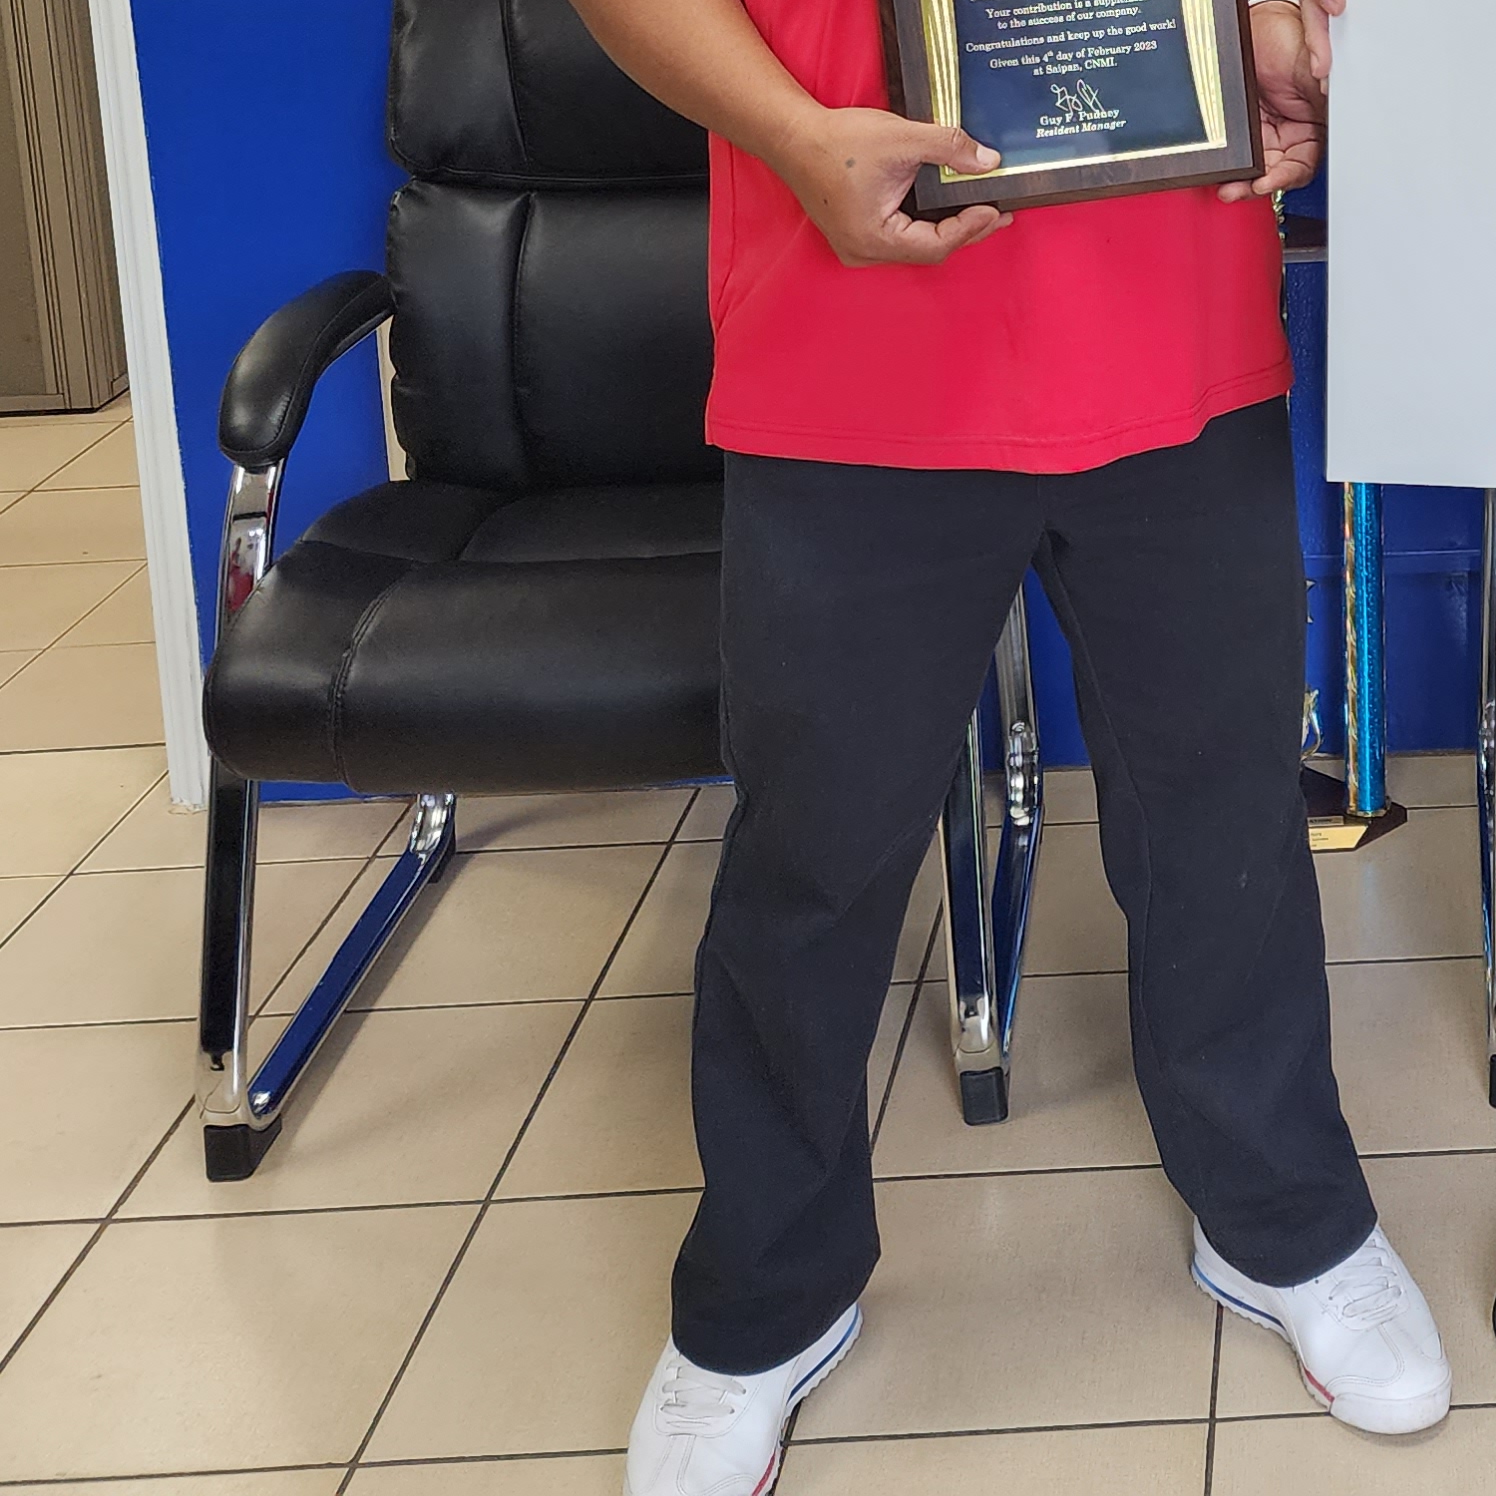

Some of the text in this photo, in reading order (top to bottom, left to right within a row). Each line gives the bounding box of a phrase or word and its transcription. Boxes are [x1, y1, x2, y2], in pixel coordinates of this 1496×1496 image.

[984, 7, 1011, 19] Your
[1013, 0, 1072, 15] contribution
[997, 21, 1008, 30] to
[1009, 17, 1027, 29] the
[1027, 14, 1064, 26] success
[1065, 11, 1077, 22] of
[1076, 11, 1095, 21] our
[965, 35, 1045, 52] Congratulations
[1046, 31, 1066, 43] and
[1067, 29, 1091, 41] keep
[1092, 29, 1106, 40] up
[1107, 25, 1123, 36] the
[1125, 22, 1147, 35] good
[989, 57, 1019, 69] Given
[1021, 54, 1041, 65] this
[1055, 51, 1074, 62] day
[1075, 48, 1086, 59] of
[1087, 44, 1132, 58] February
[1133, 40, 1158, 52] 2023
[1032, 66, 1044, 76] at
[1084, 56, 1118, 70] CNMI.
[1036, 120, 1127, 139] Resident Manager
[1039, 115, 1063, 126] Guy
